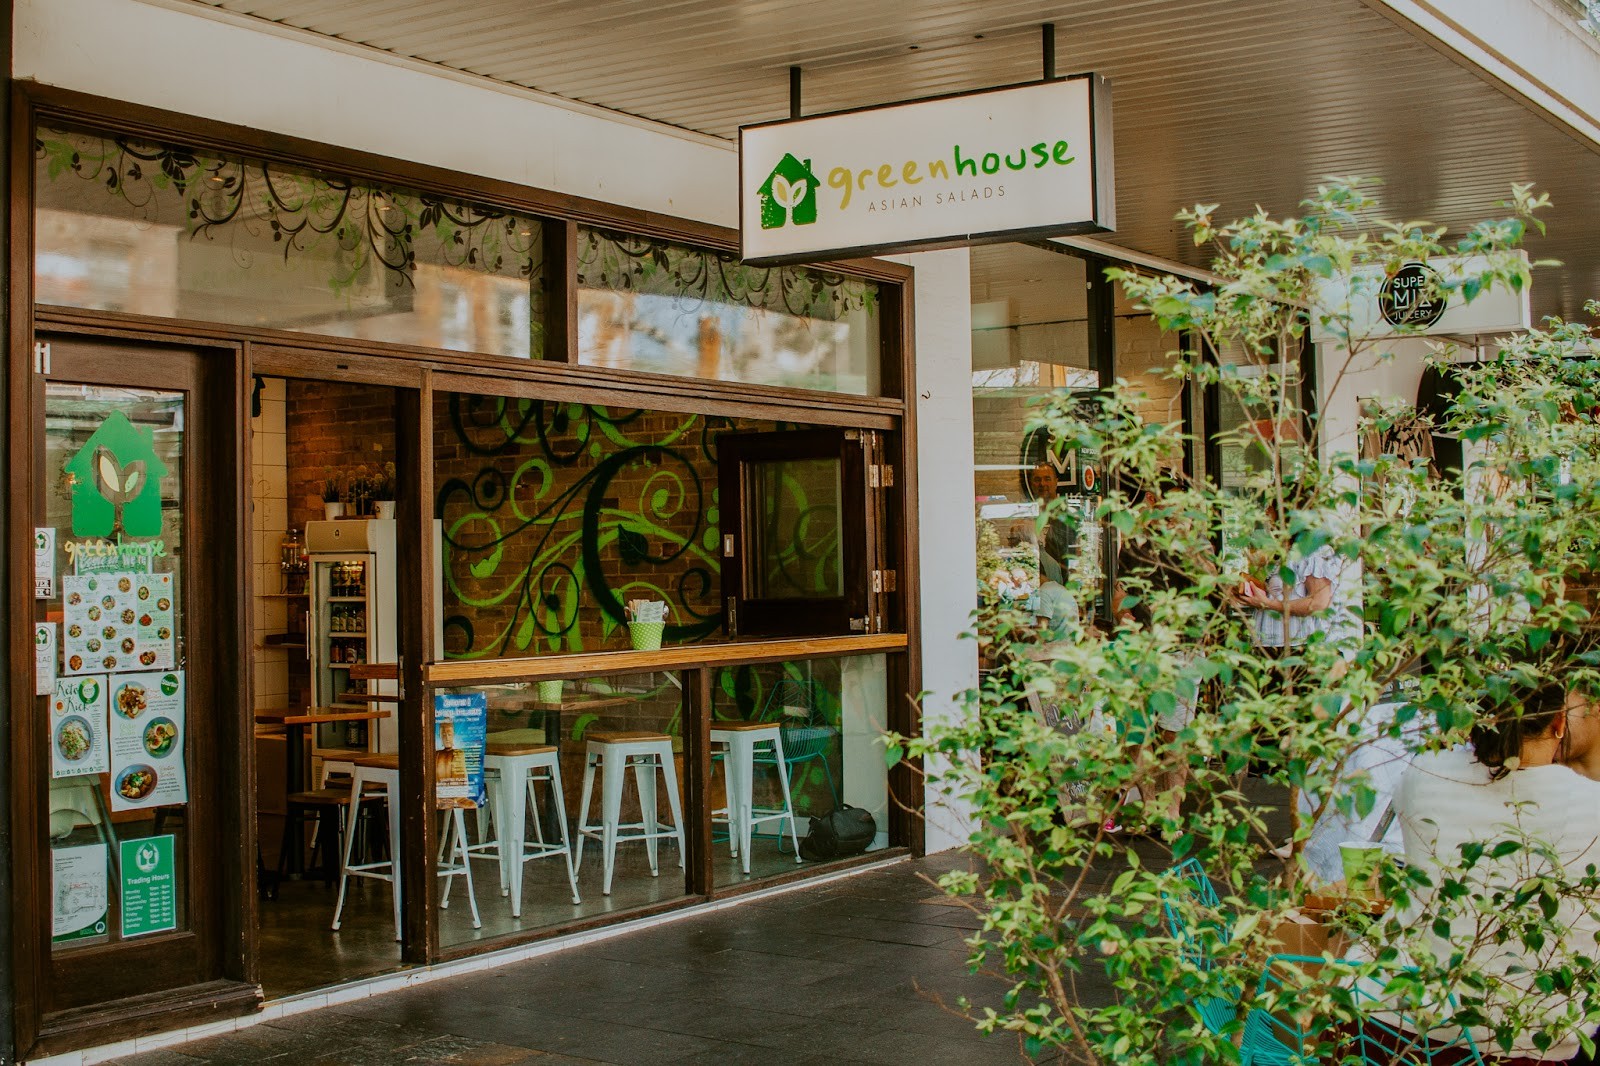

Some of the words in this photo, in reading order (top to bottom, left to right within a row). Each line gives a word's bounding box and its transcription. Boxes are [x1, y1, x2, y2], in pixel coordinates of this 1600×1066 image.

[827, 139, 1076, 211] greenhouse
[868, 195, 923, 213] ASIAN
[936, 185, 1007, 205] SALADS
[1394, 276, 1425, 288] SUPE
[1394, 309, 1433, 321] JUERY
[64, 533, 168, 565] greenhouse
[127, 876, 150, 885] Trading
